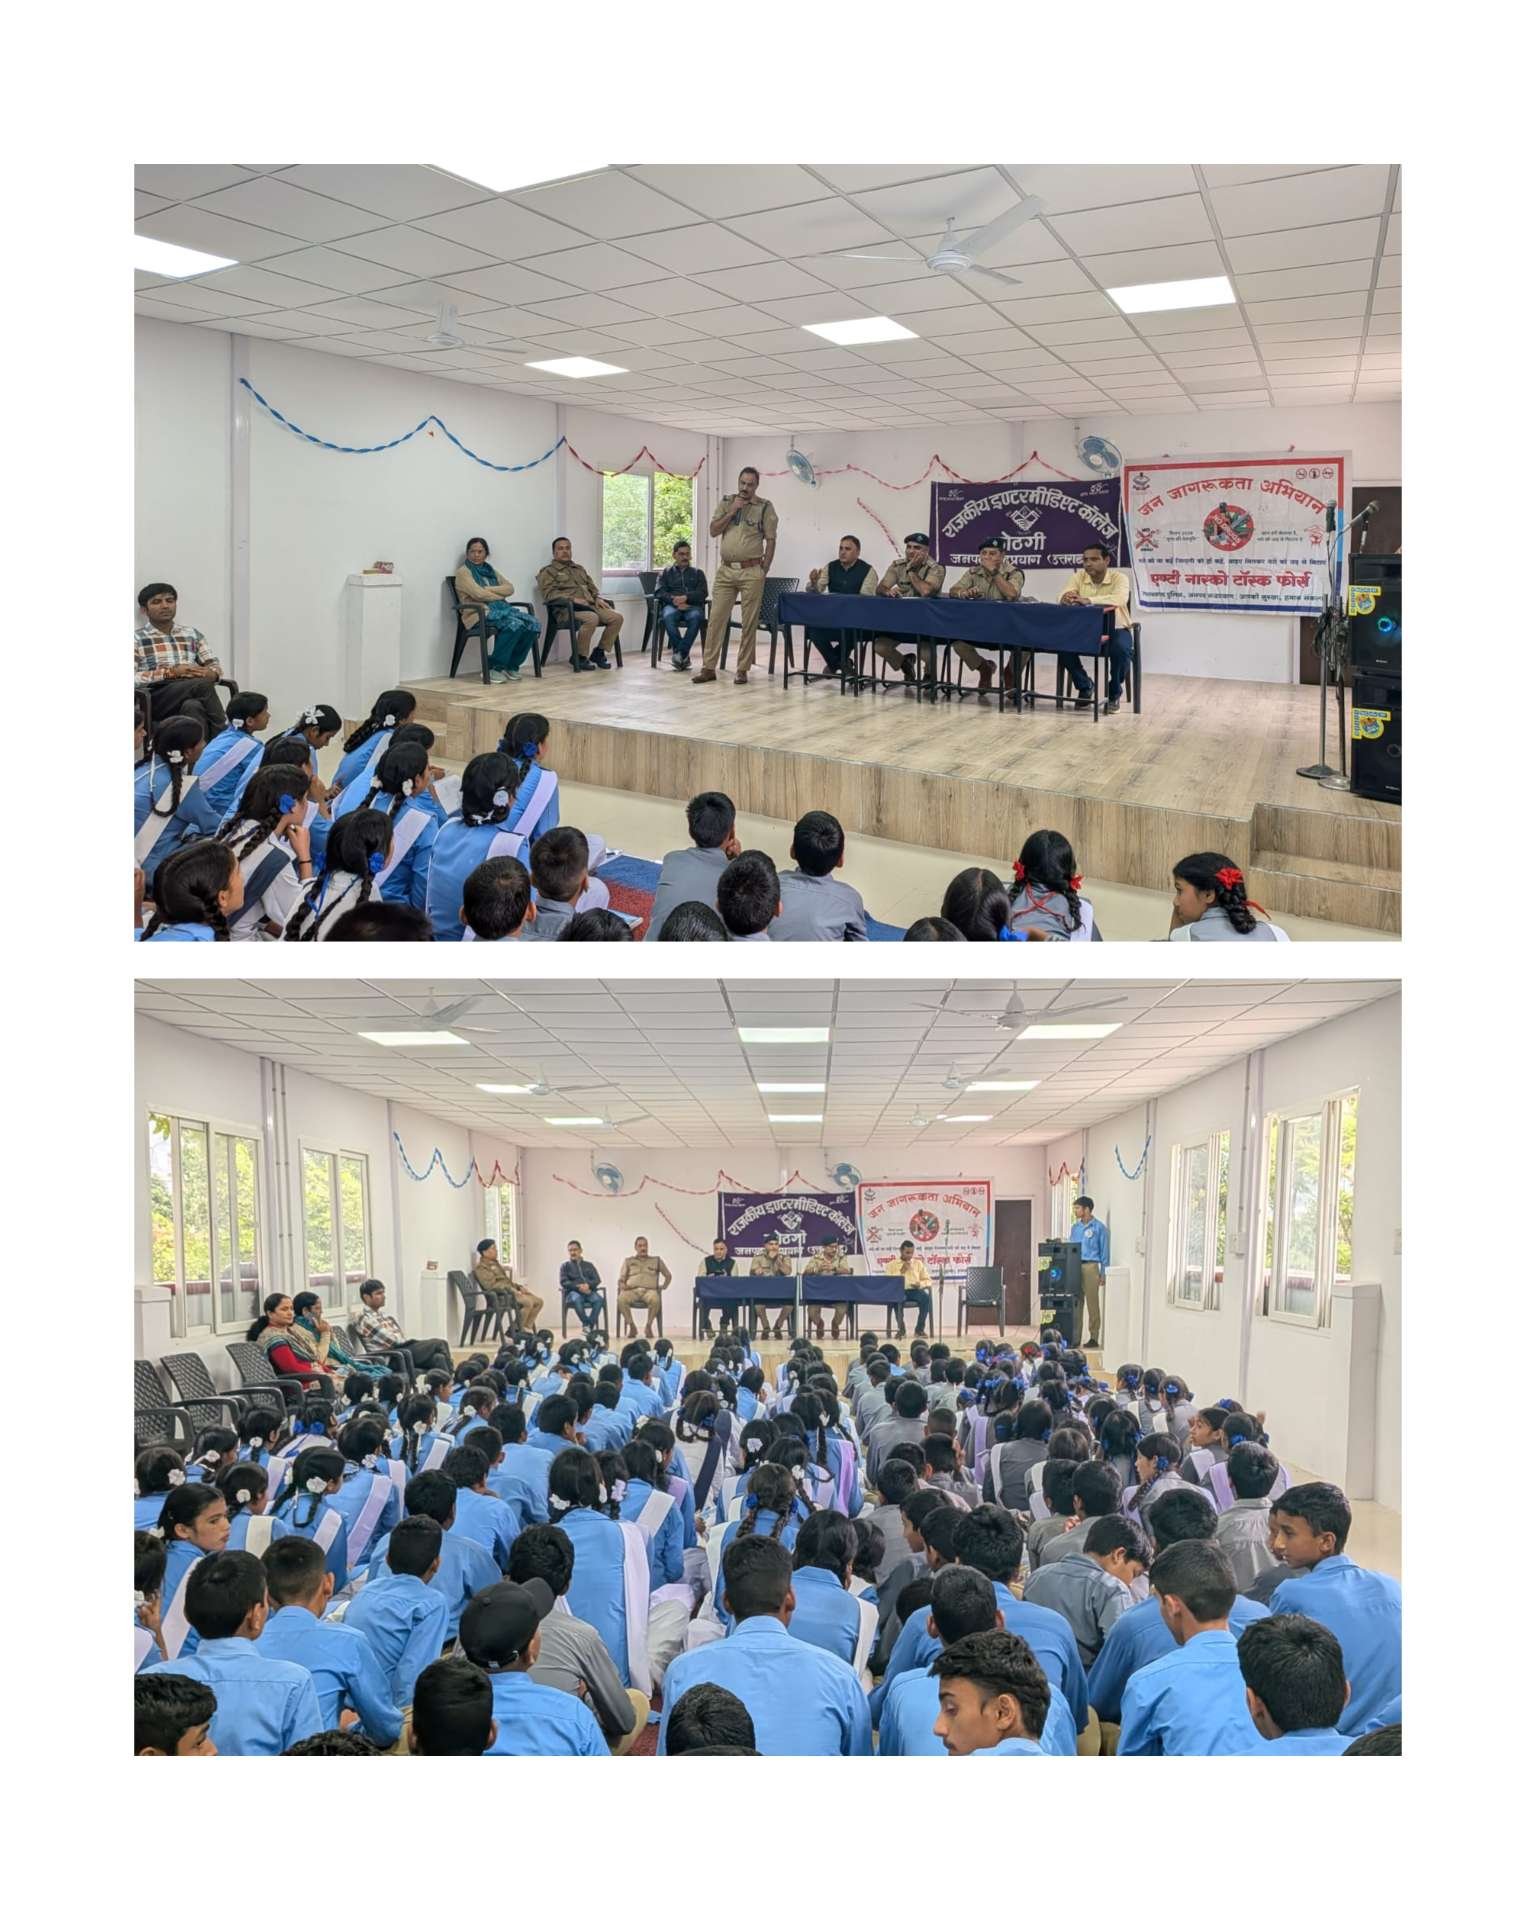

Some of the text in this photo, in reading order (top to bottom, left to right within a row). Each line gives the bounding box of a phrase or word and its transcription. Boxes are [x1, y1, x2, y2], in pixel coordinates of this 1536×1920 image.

[1137, 478, 1327, 517] जन जागरूकता अभियान
[942, 497, 990, 538] राजकीय
[1078, 501, 1119, 539] कॉलेज
[1150, 569, 1181, 587] एण्टी
[1232, 570, 1273, 588] टॉस्क
[1276, 570, 1313, 588] फोर्स
[728, 1206, 766, 1235] राजकीय
[868, 1204, 885, 1218] जन
